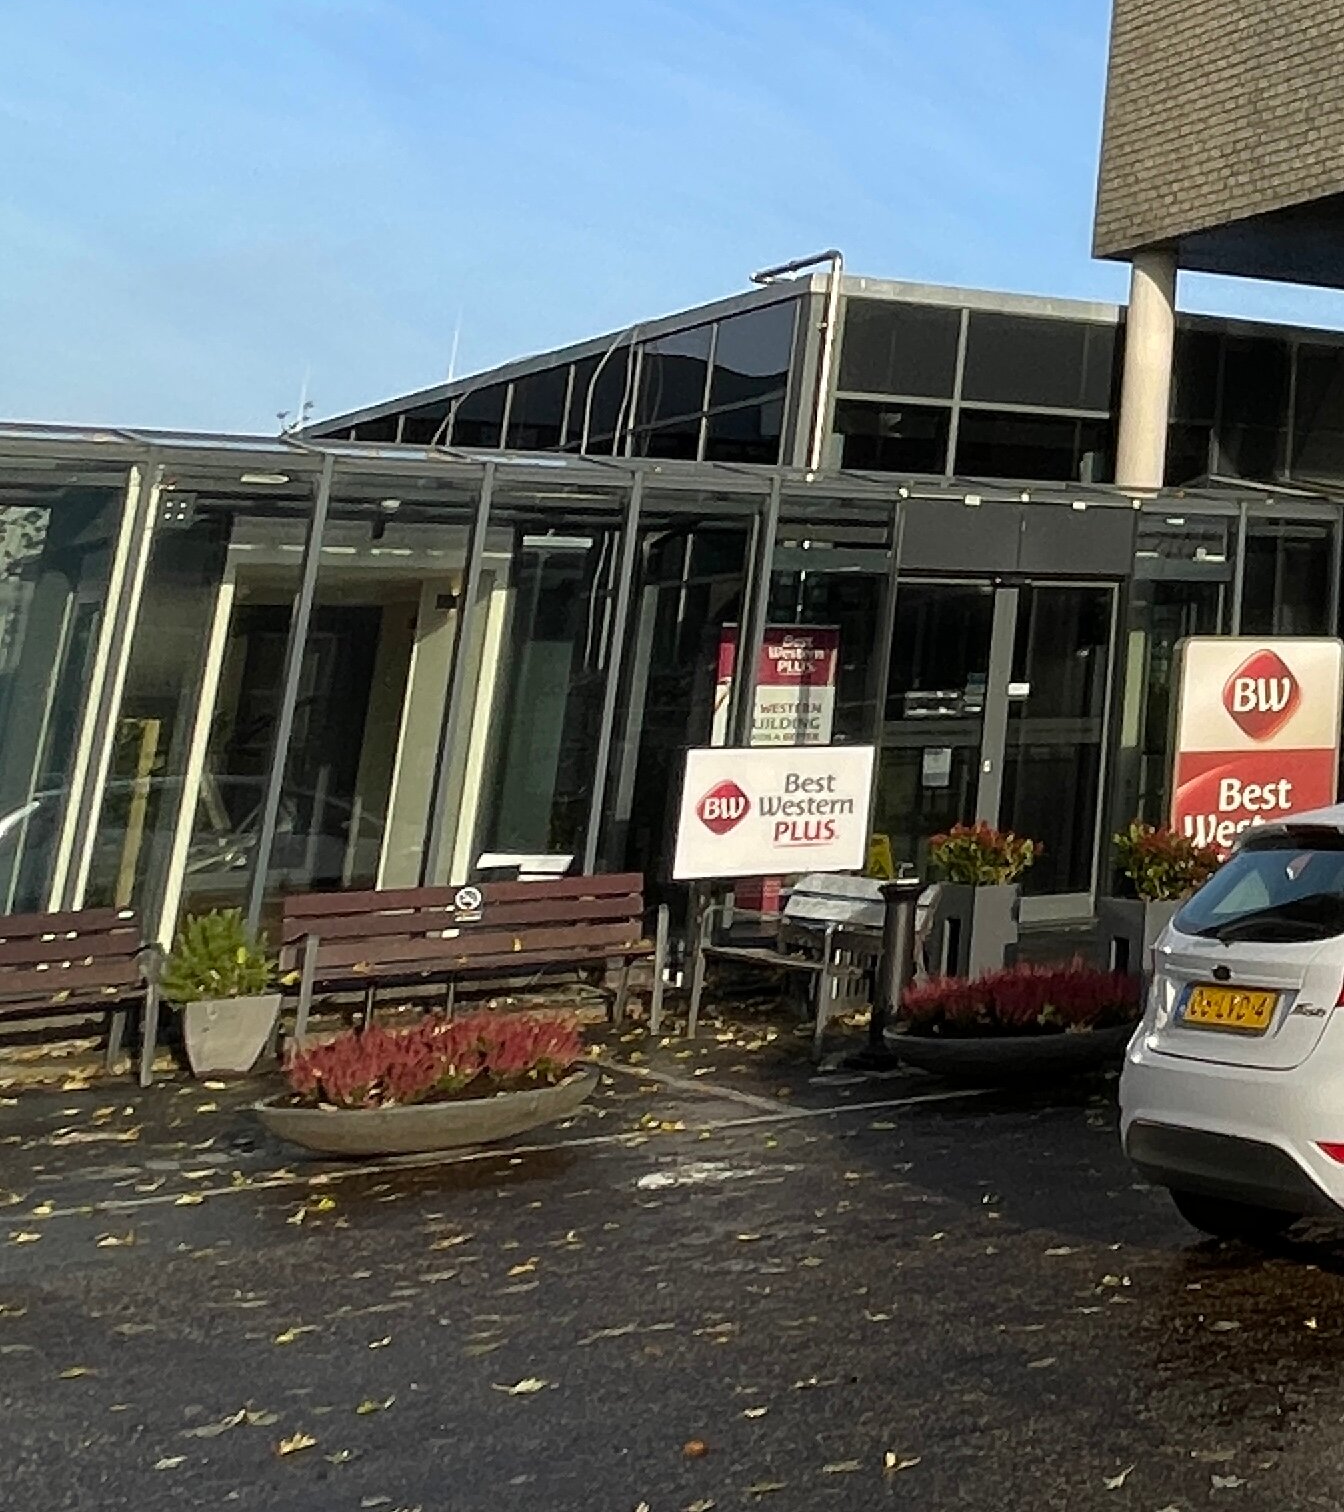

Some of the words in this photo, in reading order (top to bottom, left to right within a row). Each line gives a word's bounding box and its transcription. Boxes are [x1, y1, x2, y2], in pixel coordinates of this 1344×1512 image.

[1232, 676, 1291, 713] BW
[784, 772, 836, 794] Best
[759, 796, 854, 817] Western
[1218, 777, 1293, 813] Best
[702, 796, 746, 820] BW
[774, 819, 836, 842] PLUS
